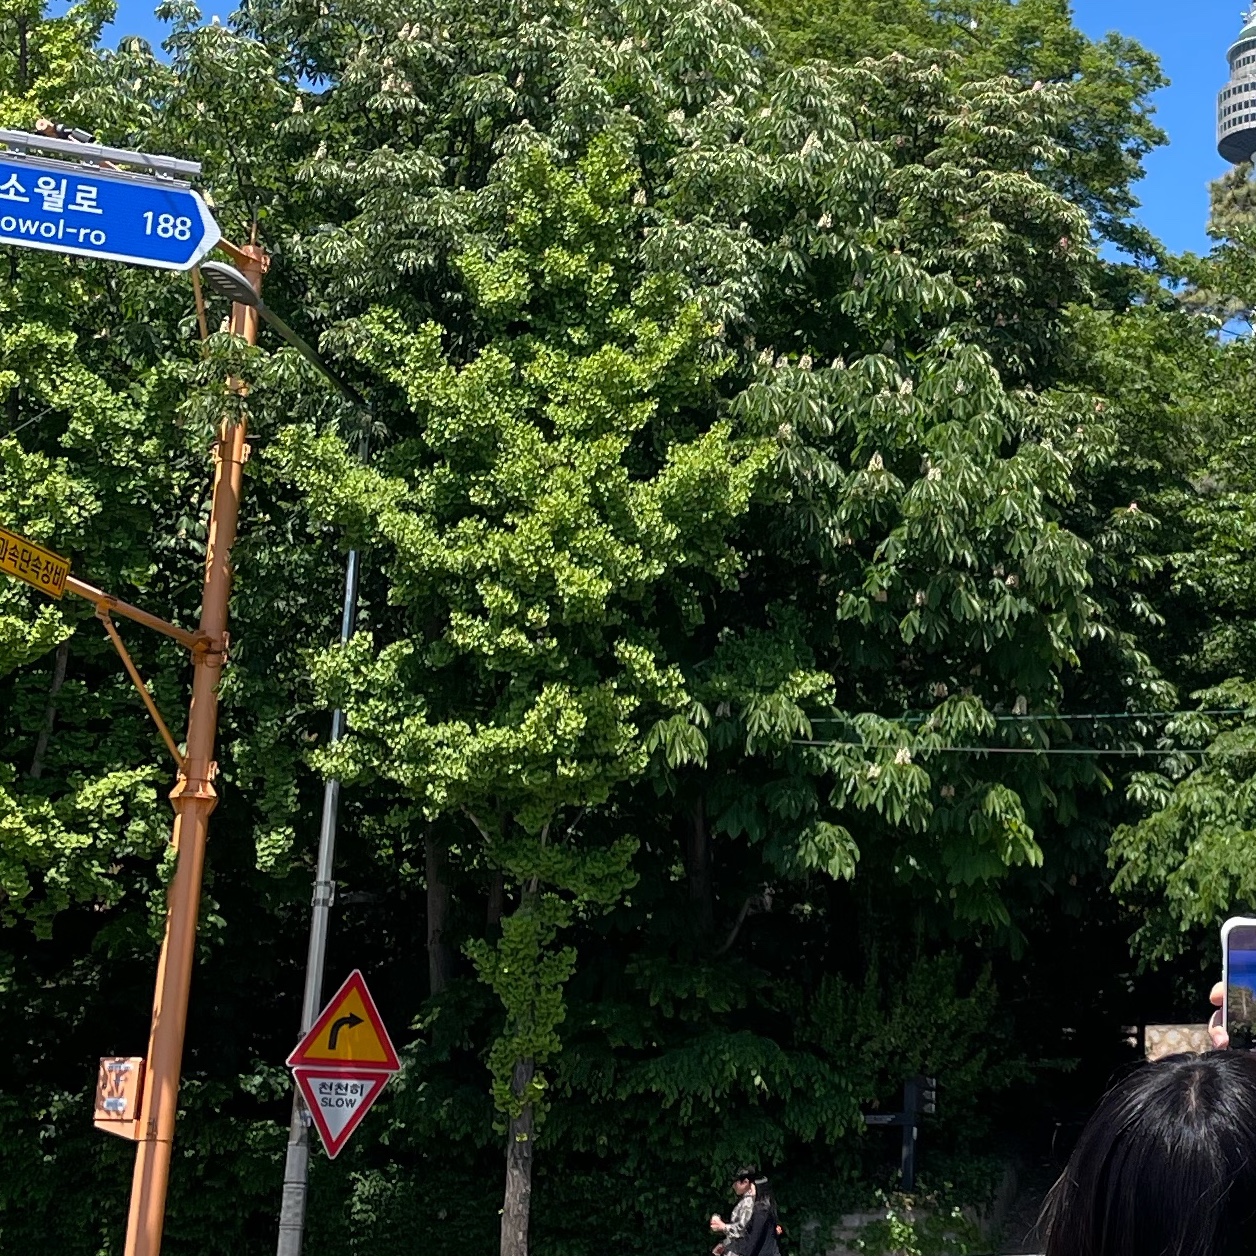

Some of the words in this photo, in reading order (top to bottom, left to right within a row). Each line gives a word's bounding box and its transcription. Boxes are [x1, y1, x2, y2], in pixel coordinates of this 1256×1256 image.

[0, 173, 103, 214] 소월로
[143, 211, 192, 241] 188
[319, 1081, 364, 1096] 천천히
[321, 1097, 356, 1108] SLOW
